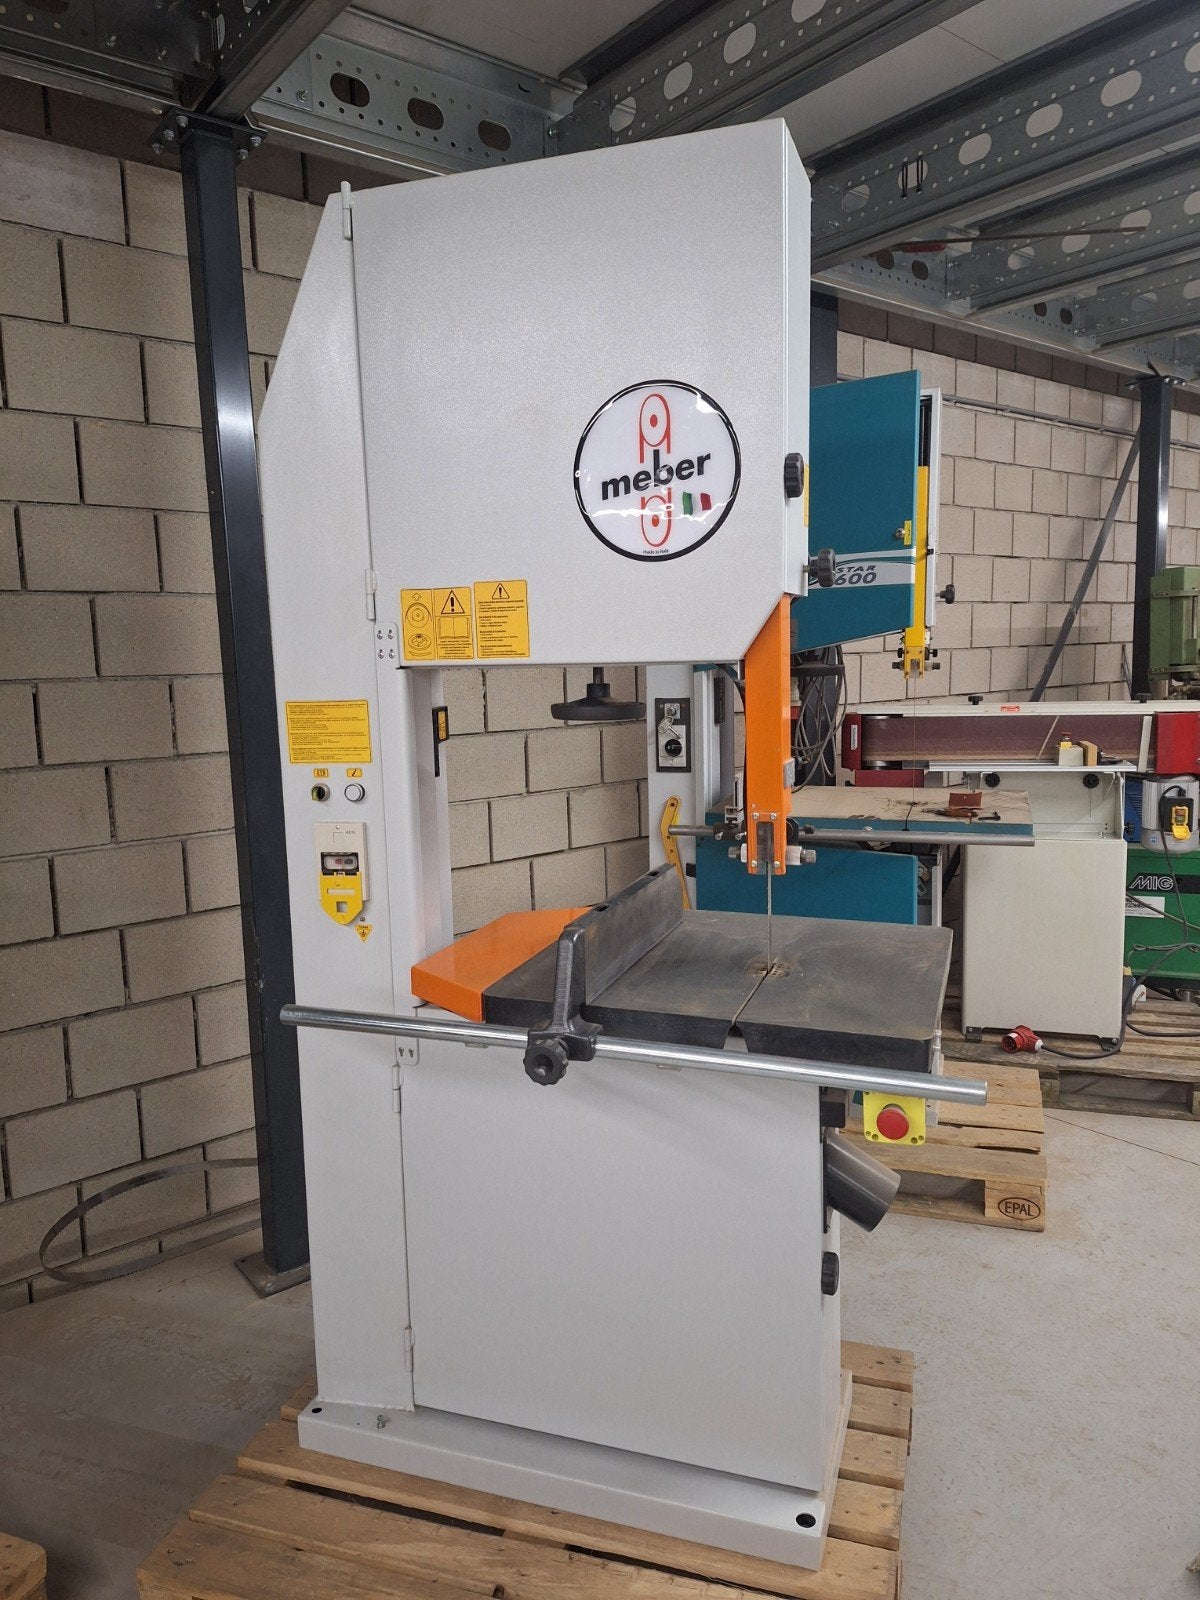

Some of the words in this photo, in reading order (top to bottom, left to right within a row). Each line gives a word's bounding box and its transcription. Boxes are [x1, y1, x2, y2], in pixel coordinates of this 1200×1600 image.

[601, 449, 712, 501] meber
[836, 564, 877, 574] STAR
[834, 571, 877, 586] 600
[1129, 875, 1174, 891] MIG
[1004, 1201, 1035, 1217] EPAL
